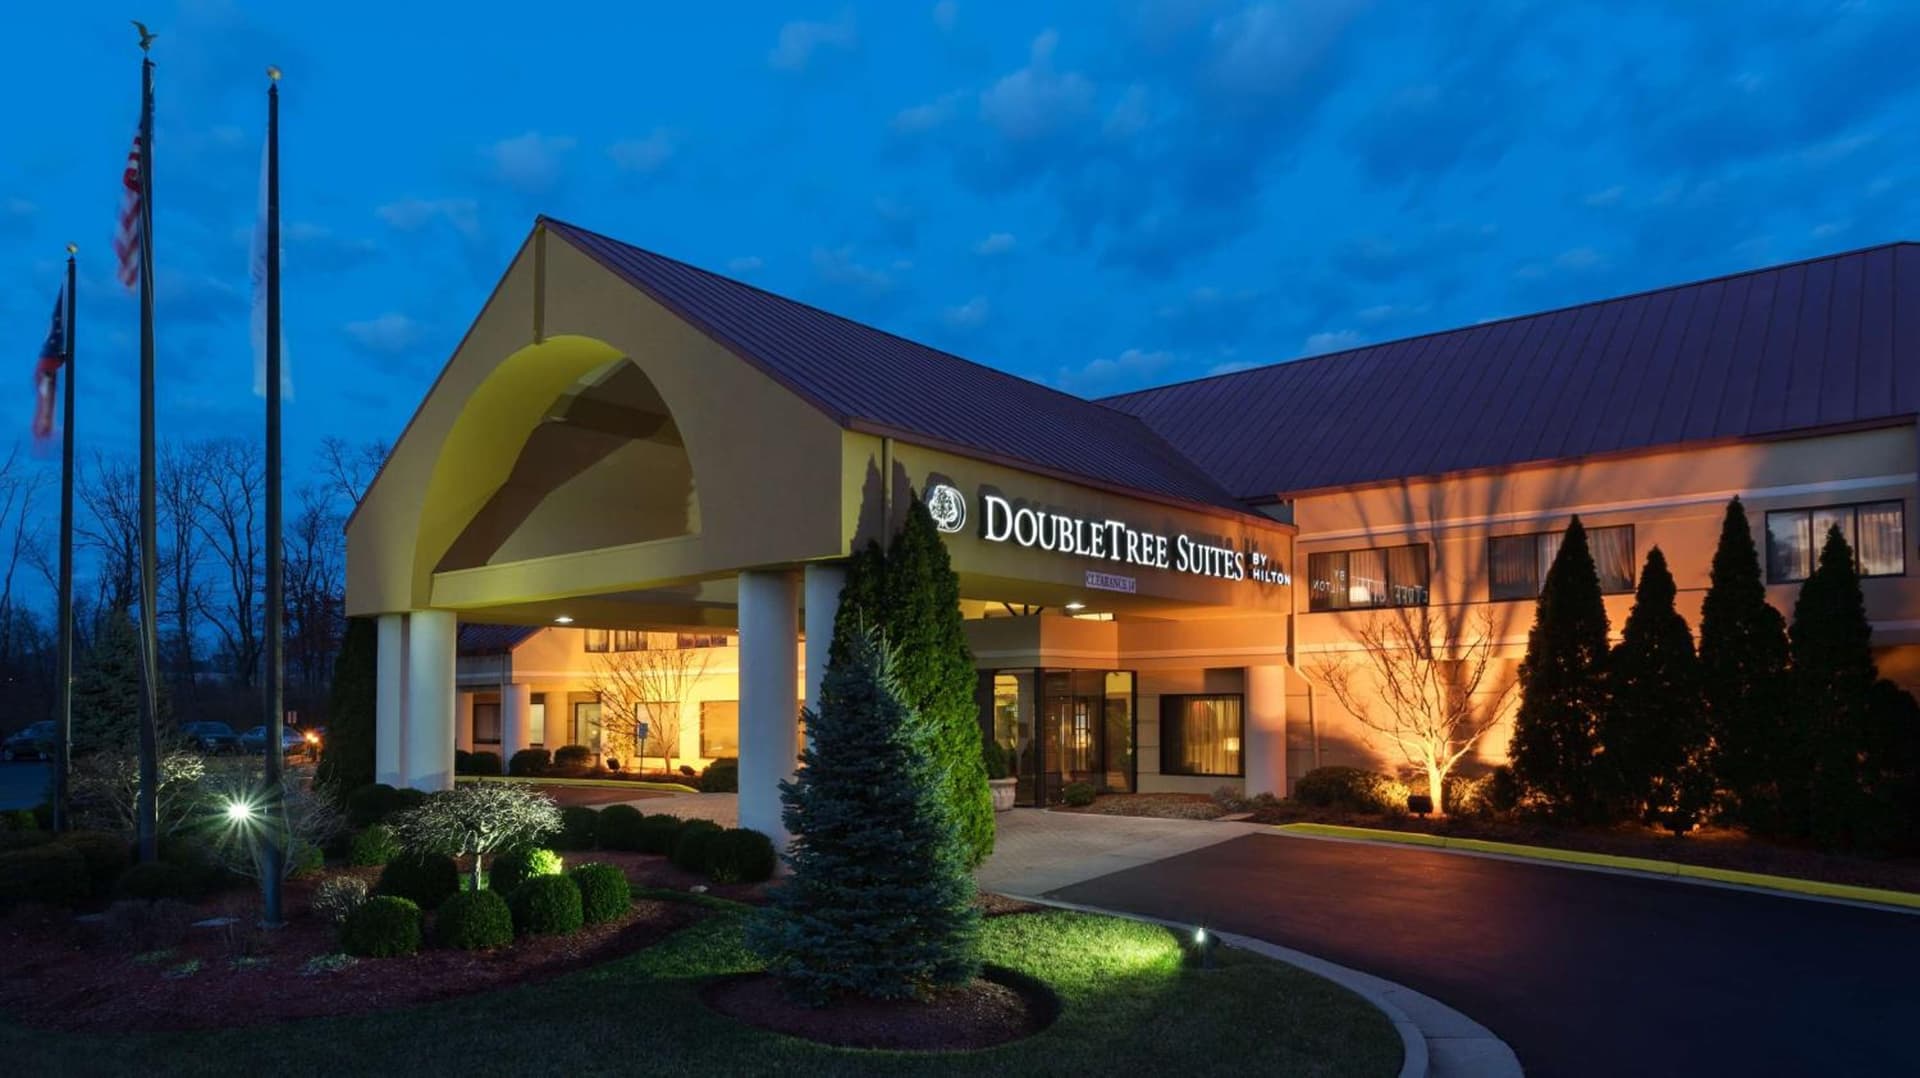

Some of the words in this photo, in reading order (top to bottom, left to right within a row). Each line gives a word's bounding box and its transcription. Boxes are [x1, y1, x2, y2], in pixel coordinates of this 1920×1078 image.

[1176, 534, 1244, 581] SUITES
[1252, 552, 1267, 566] BY
[1252, 568, 1291, 586] HILTON
